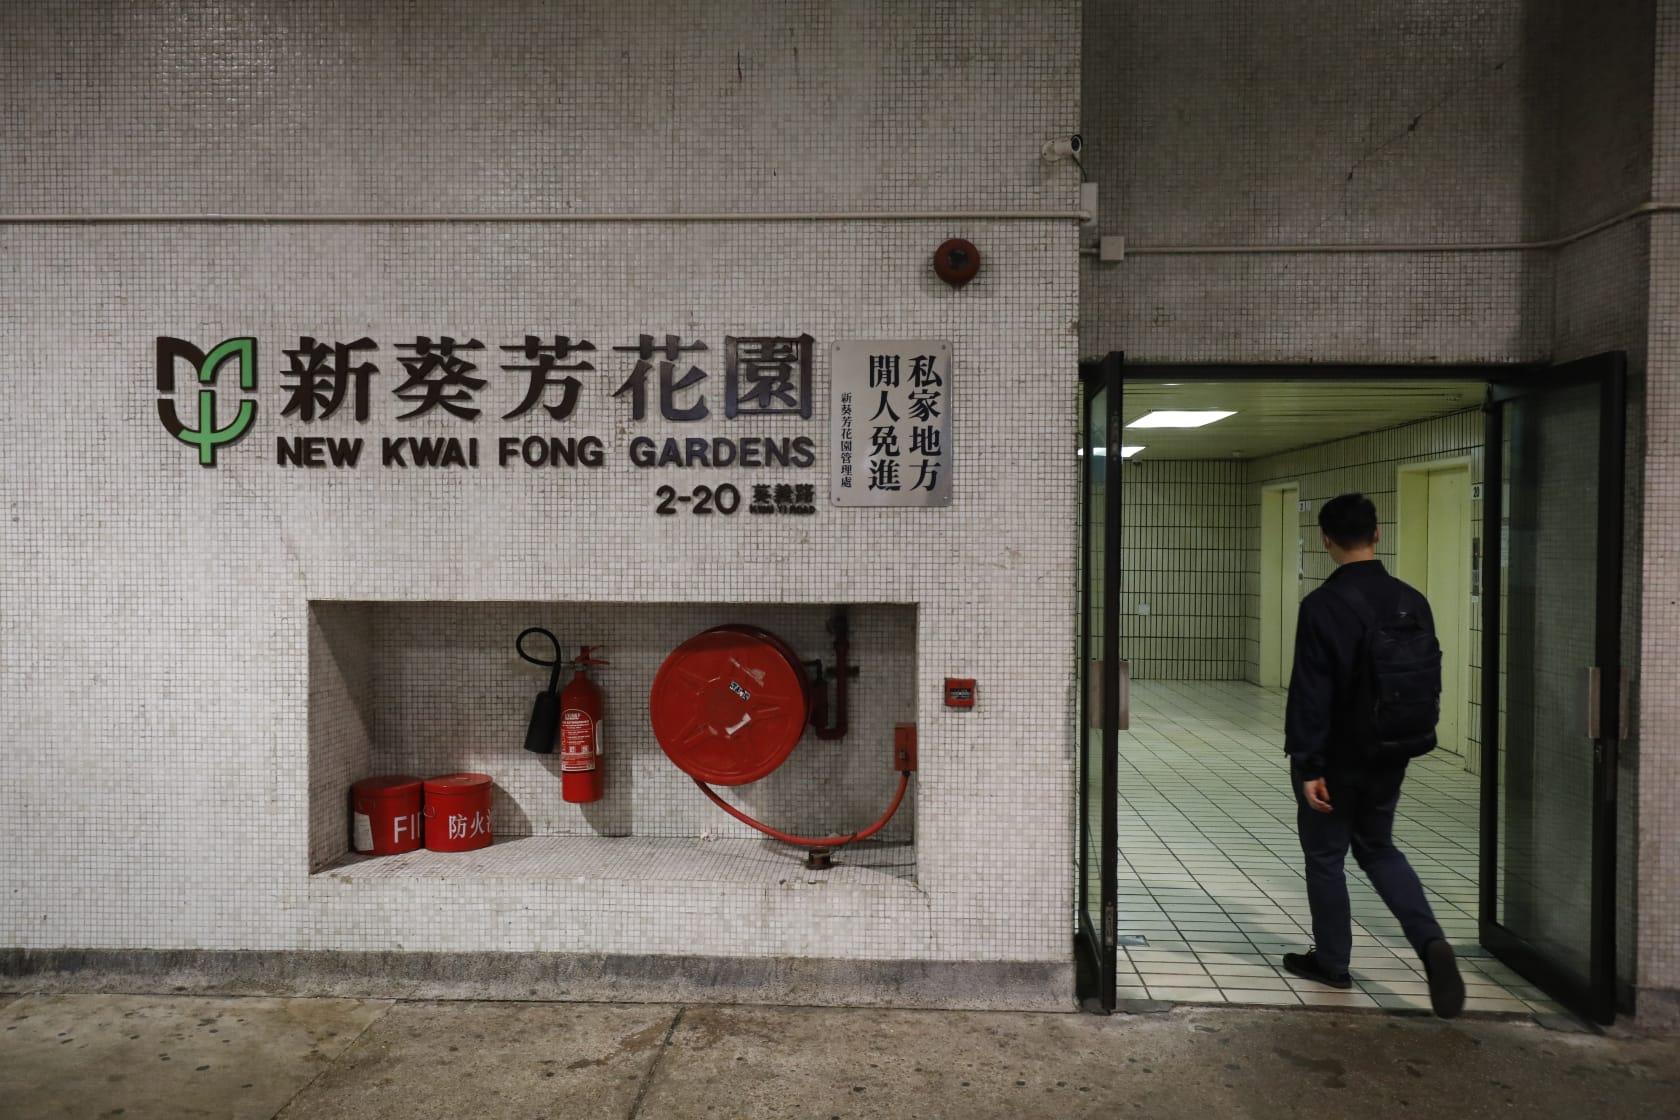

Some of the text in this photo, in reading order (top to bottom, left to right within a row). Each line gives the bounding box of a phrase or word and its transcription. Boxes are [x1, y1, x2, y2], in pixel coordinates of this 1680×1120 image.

[279, 333, 815, 421] 新葵芳花園
[907, 354, 943, 491] 私家地方
[277, 435, 815, 468] NEW KWAI FONG GARDENS
[656, 483, 740, 515] 2-20
[393, 812, 421, 844] FI
